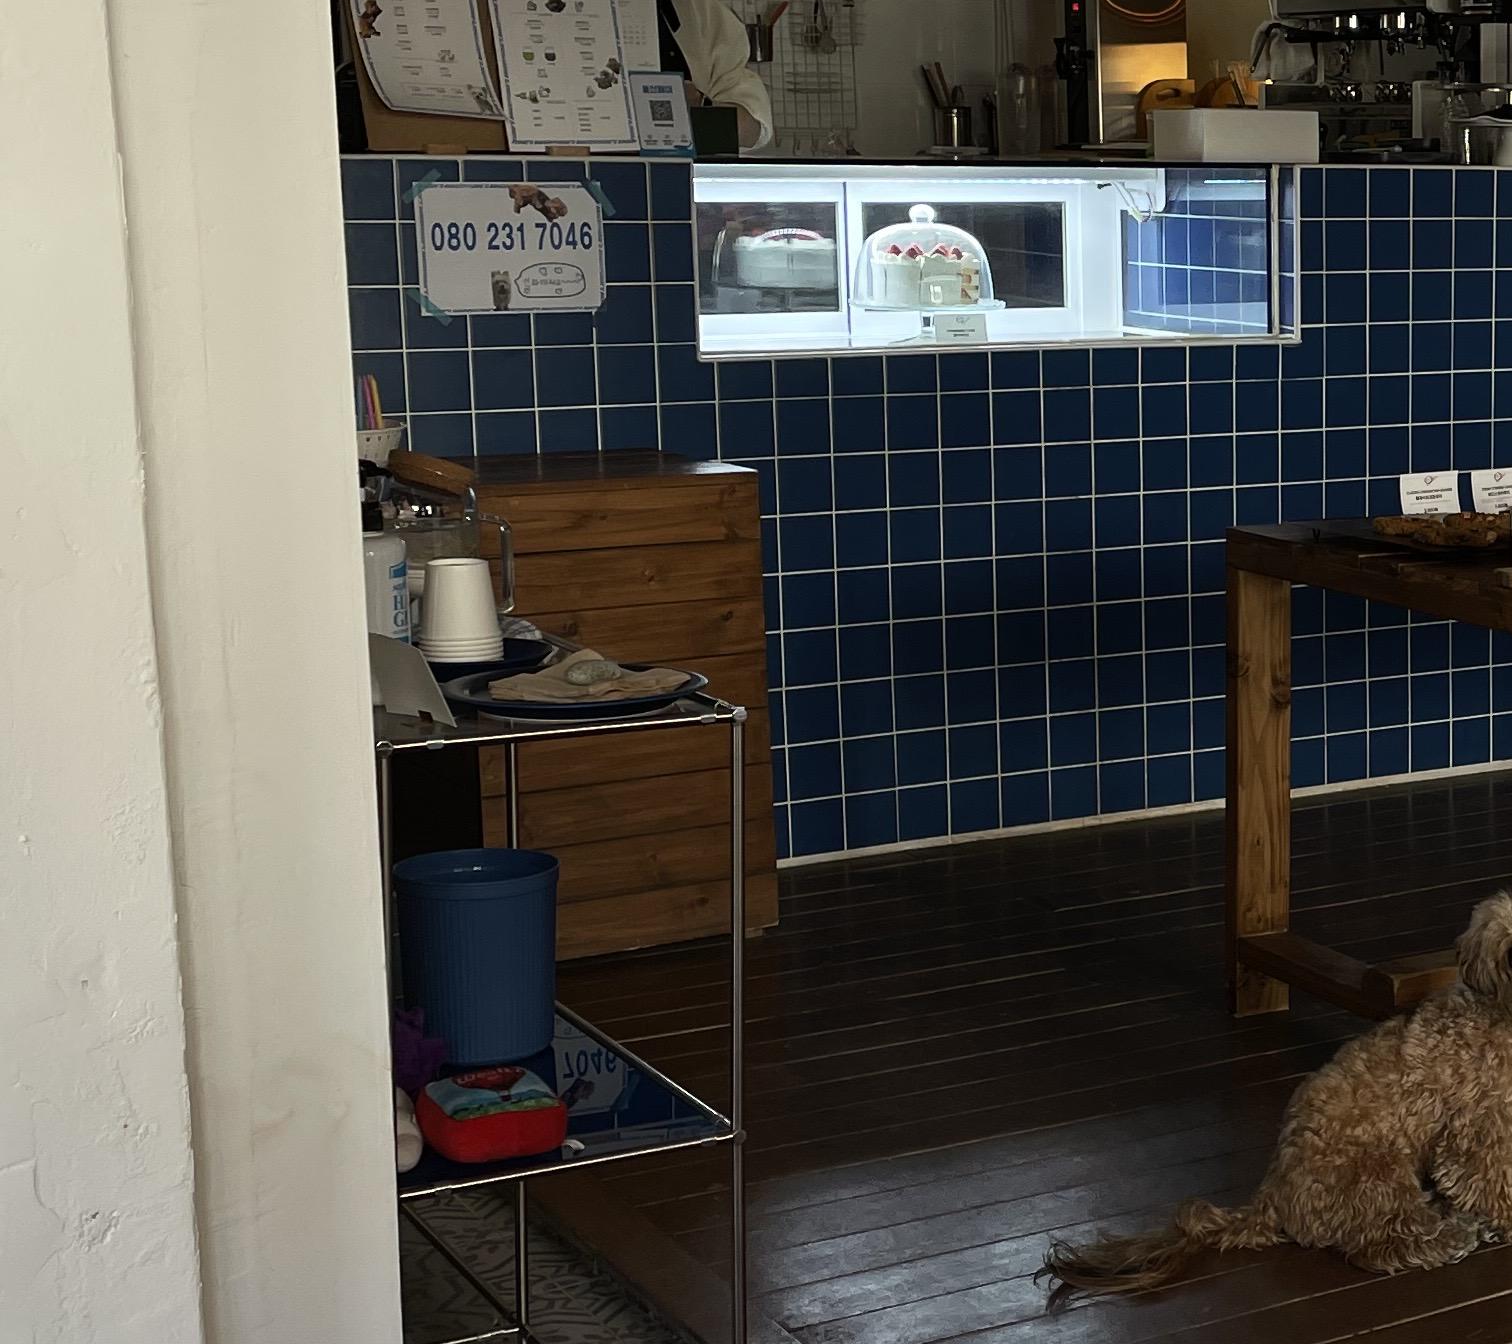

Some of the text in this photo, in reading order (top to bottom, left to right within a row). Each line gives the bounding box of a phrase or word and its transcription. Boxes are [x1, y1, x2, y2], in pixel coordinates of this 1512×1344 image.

[431, 222, 593, 251] 080 231 7046
